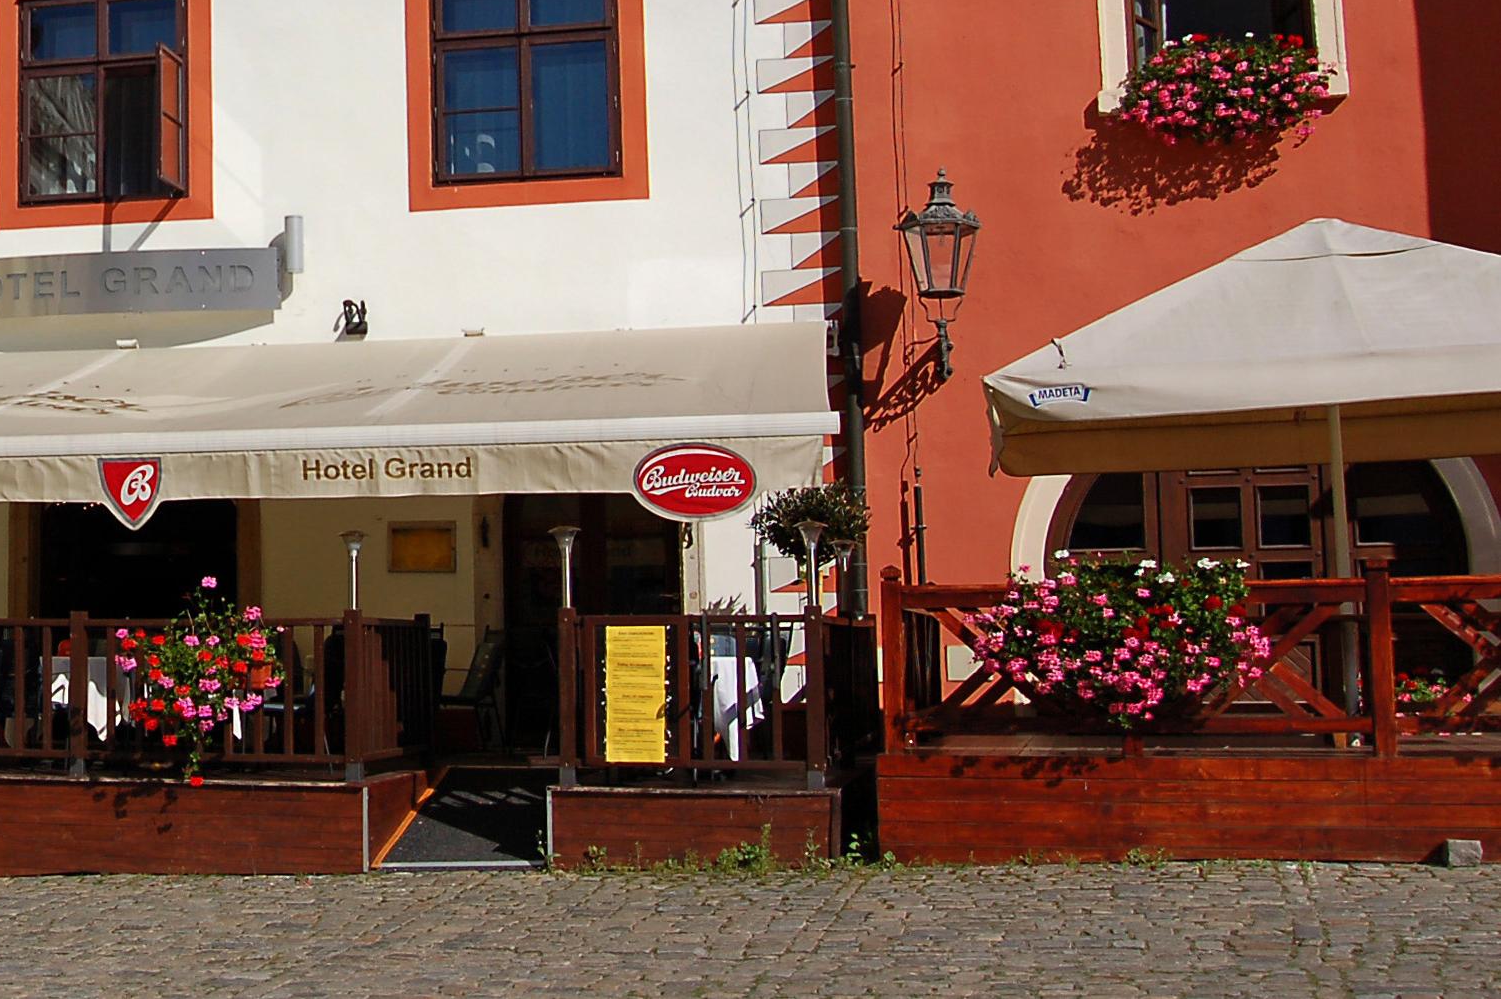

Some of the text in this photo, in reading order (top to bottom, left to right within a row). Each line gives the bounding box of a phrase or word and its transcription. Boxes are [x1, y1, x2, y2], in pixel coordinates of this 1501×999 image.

[101, 264, 255, 295] GRAND
[1038, 386, 1081, 399] MADETA
[302, 456, 472, 481] Hotel Grand
[642, 465, 743, 491] Budweiser
[684, 482, 742, 498] Budvar
